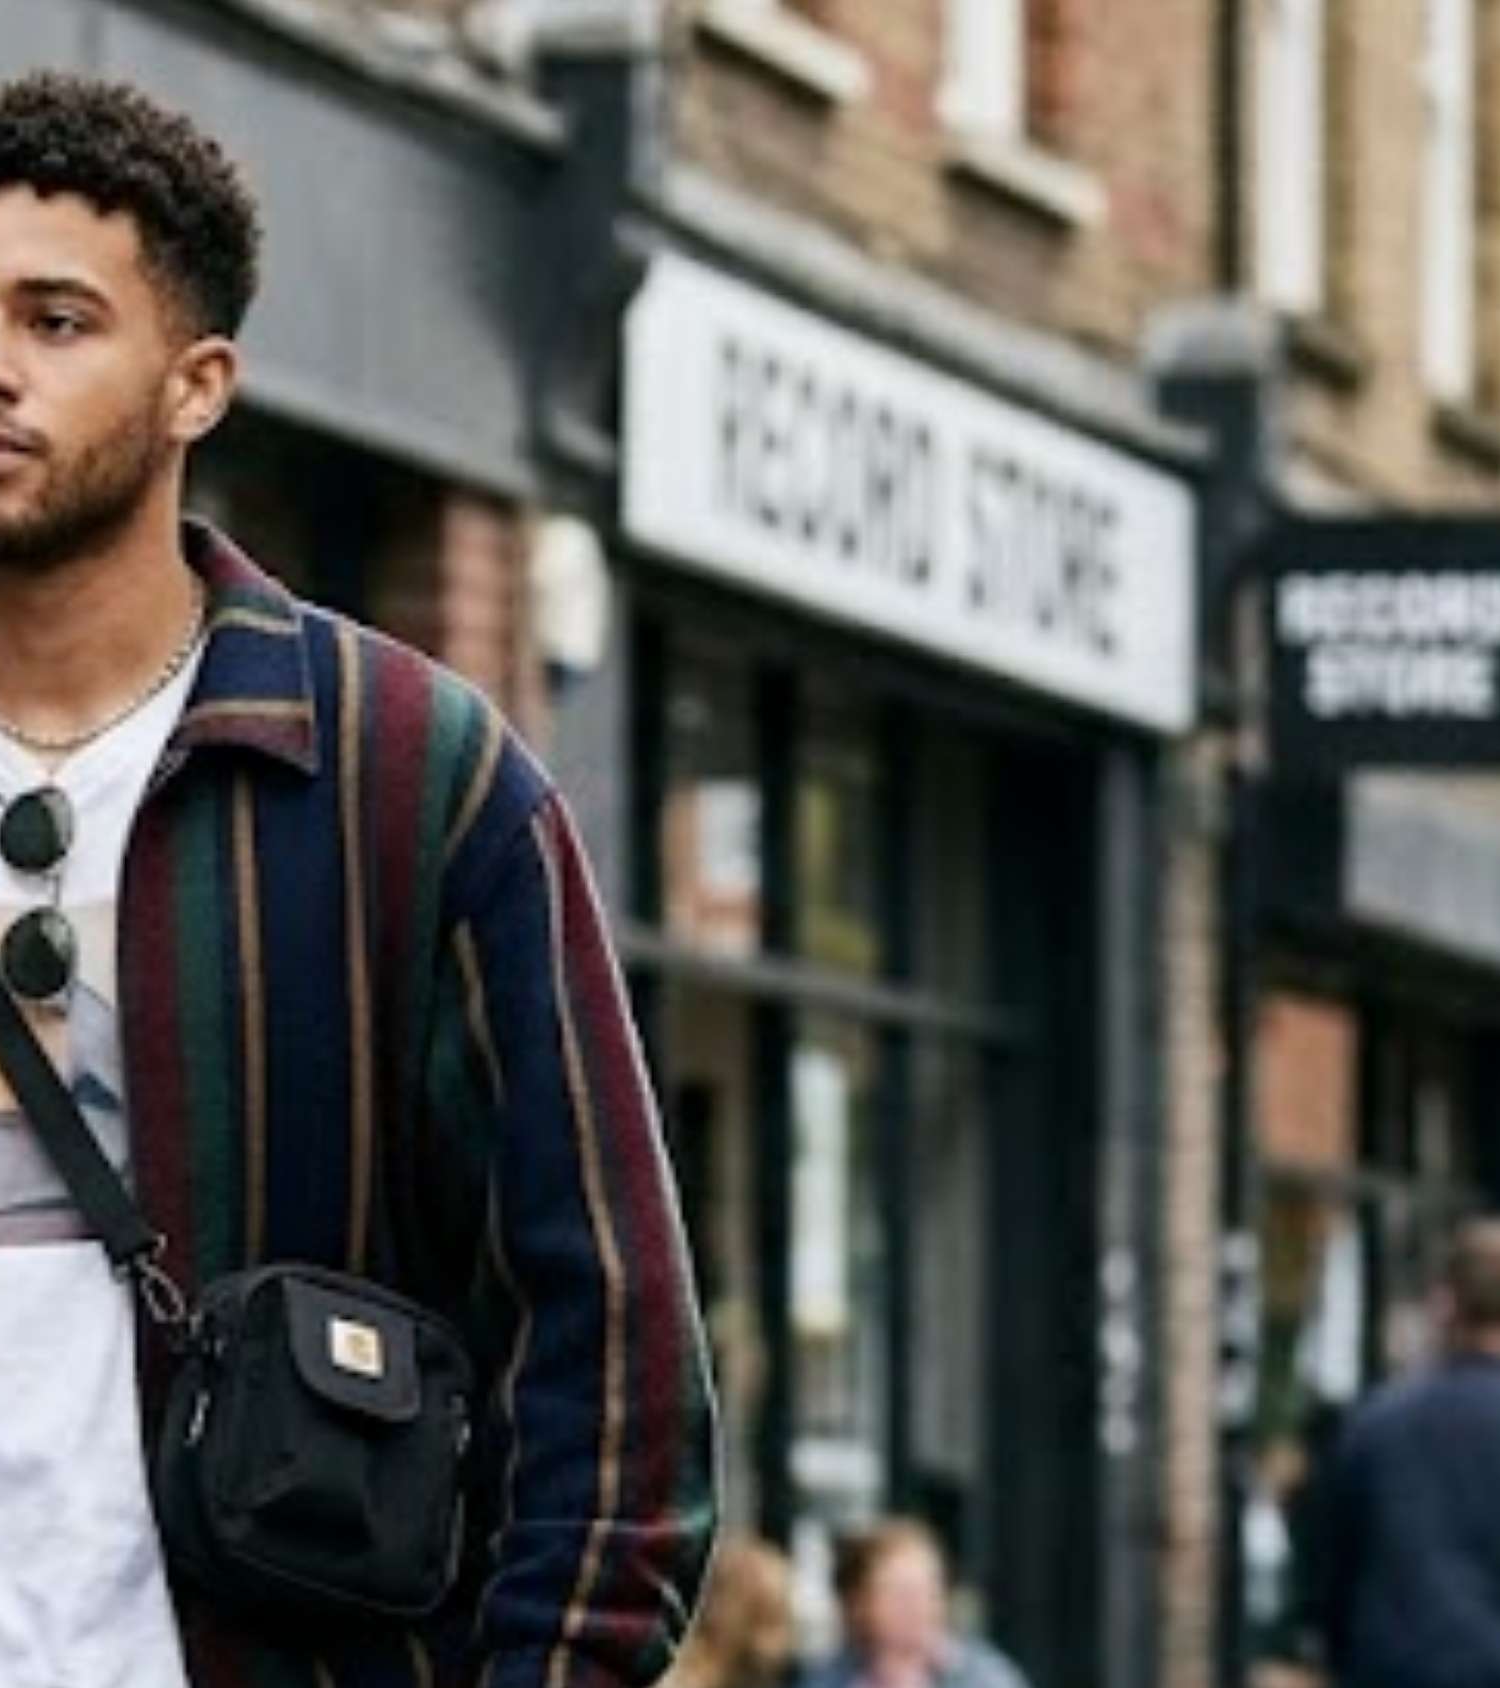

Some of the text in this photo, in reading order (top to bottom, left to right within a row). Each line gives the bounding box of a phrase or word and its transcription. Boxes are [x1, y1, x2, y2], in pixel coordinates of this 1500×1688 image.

[718, 335, 1120, 658] RECORD STORE
[1306, 646, 1495, 719] STORE
